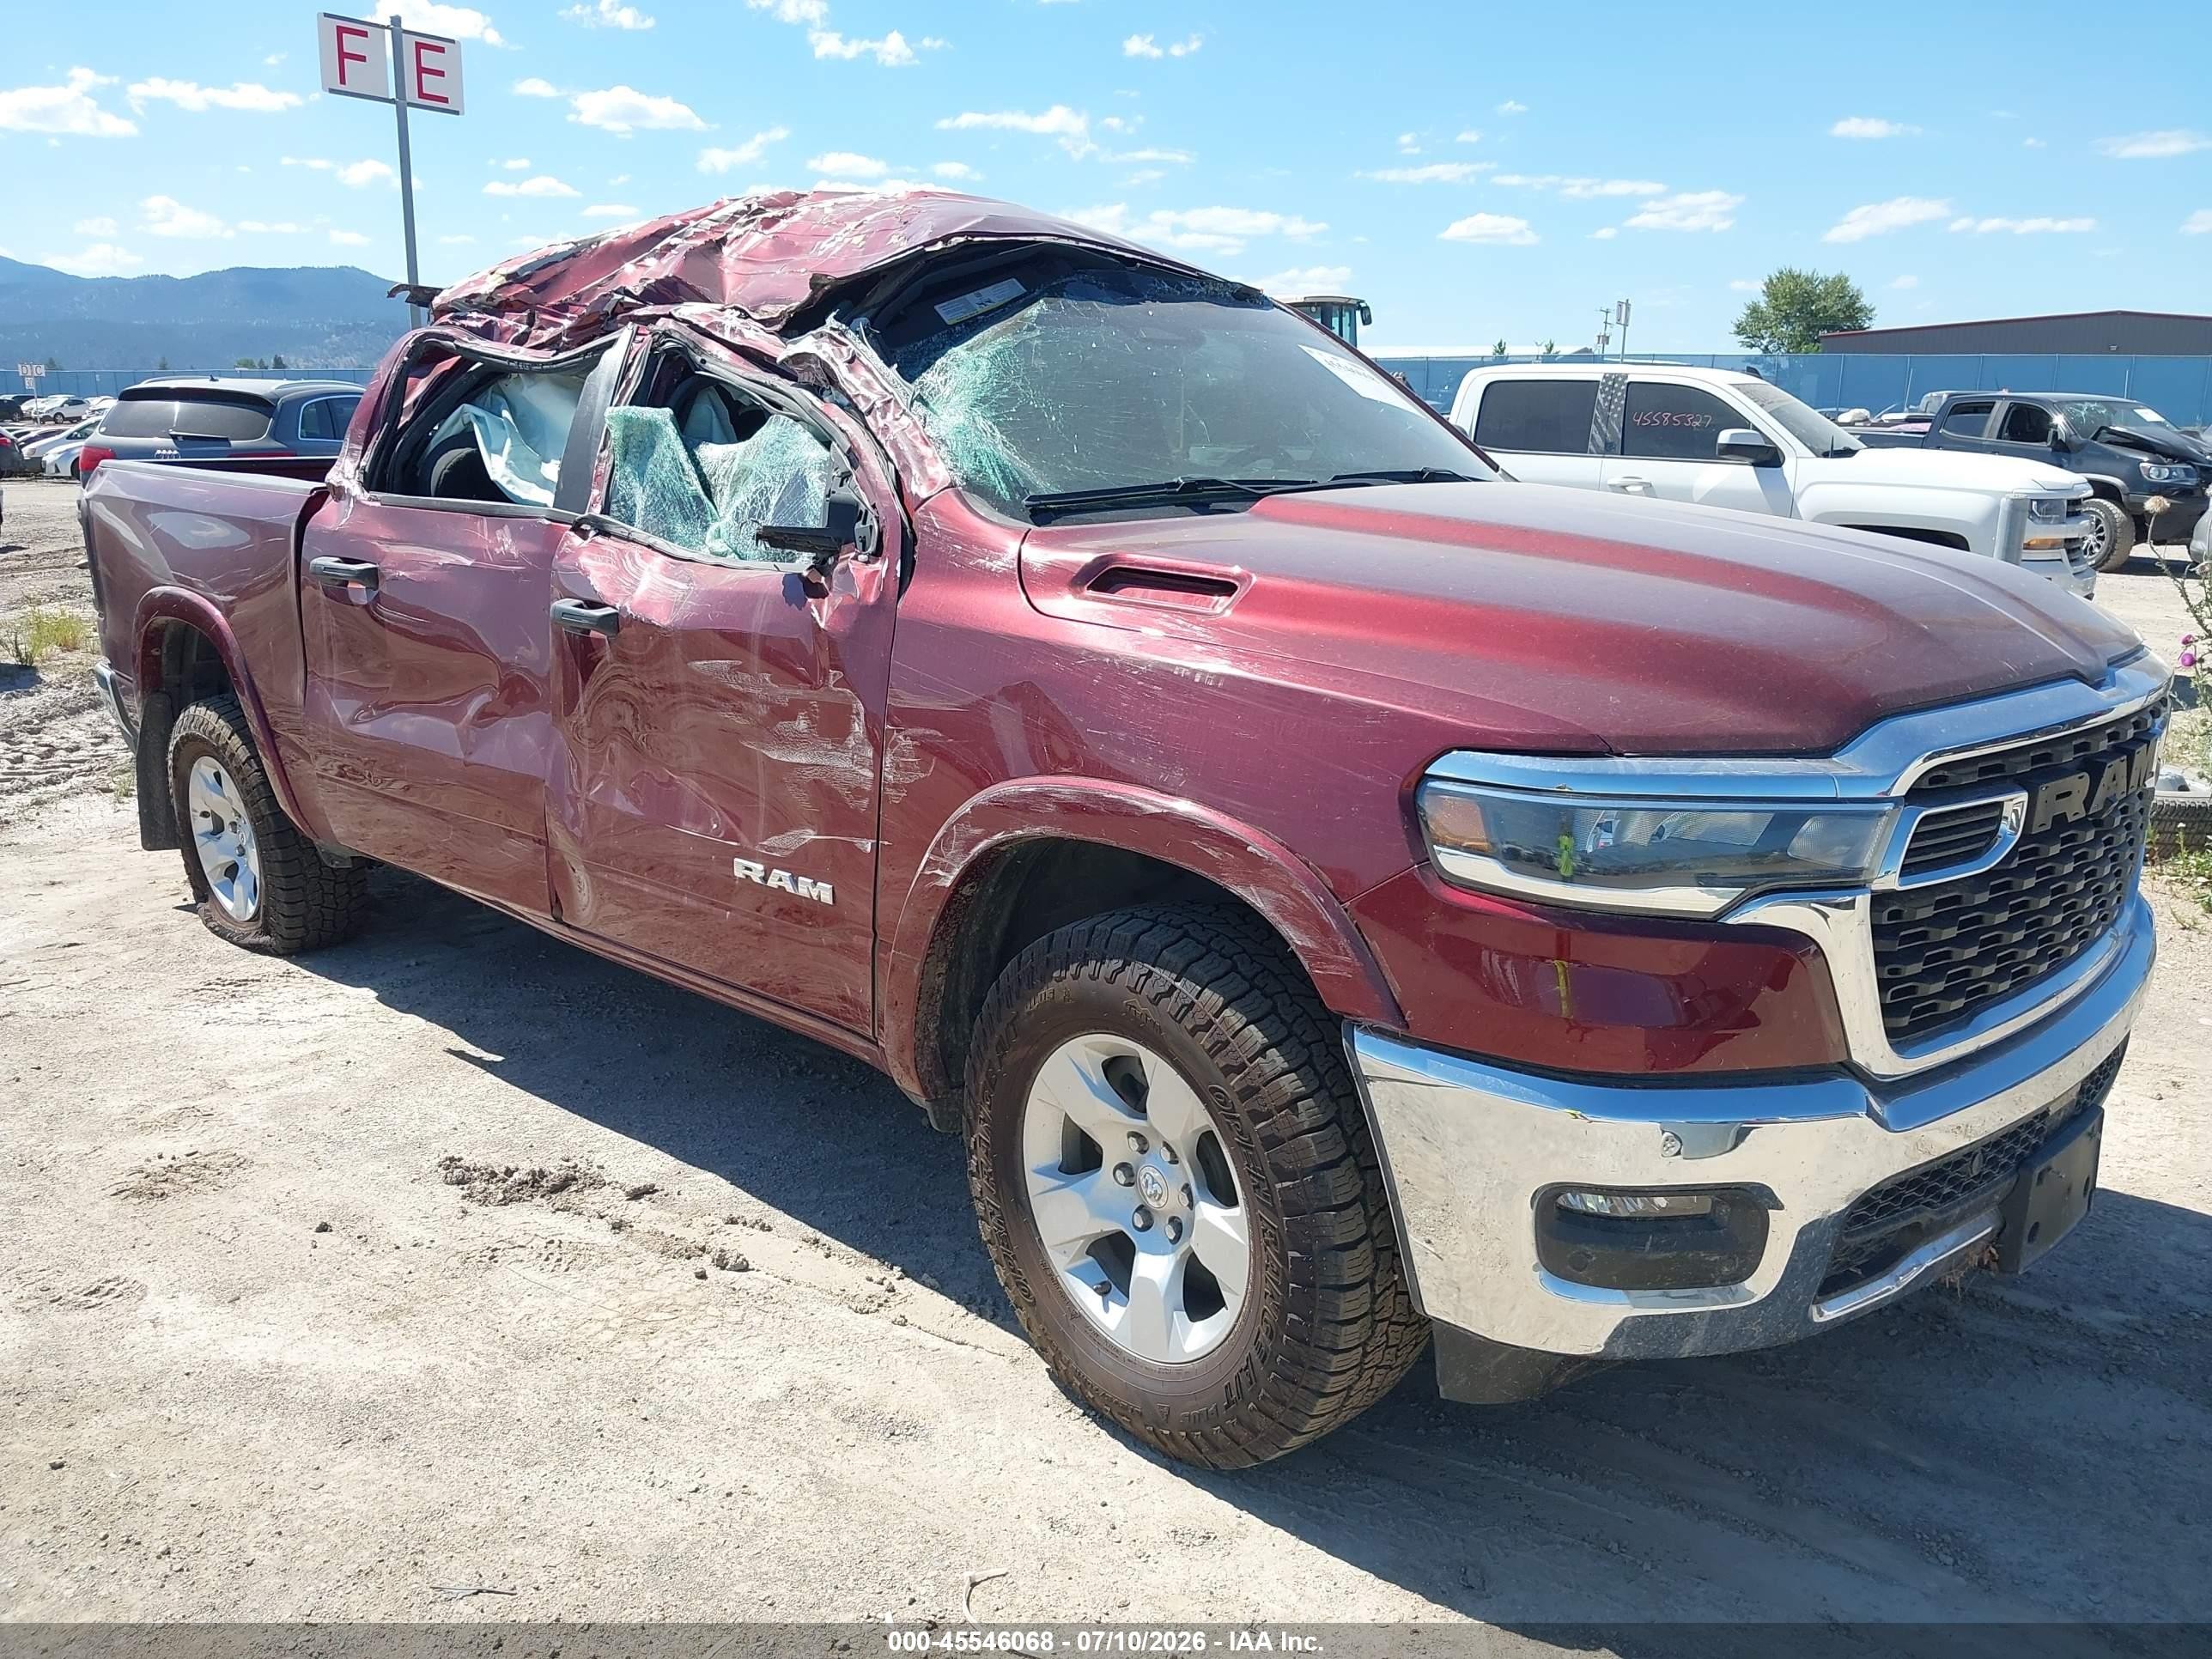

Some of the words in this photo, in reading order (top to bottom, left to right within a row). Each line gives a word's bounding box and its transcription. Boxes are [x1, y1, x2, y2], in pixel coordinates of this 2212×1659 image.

[336, 25, 368, 86] F
[414, 40, 449, 104] E
[21, 365, 28, 375] D
[34, 365, 43, 375] C
[1632, 411, 1712, 428] 45585327
[2030, 734, 2159, 835] RAM
[733, 857, 834, 906] RAM
[1207, 1084, 1272, 1205] OPEN
[1223, 1350, 1257, 1413] A/T
